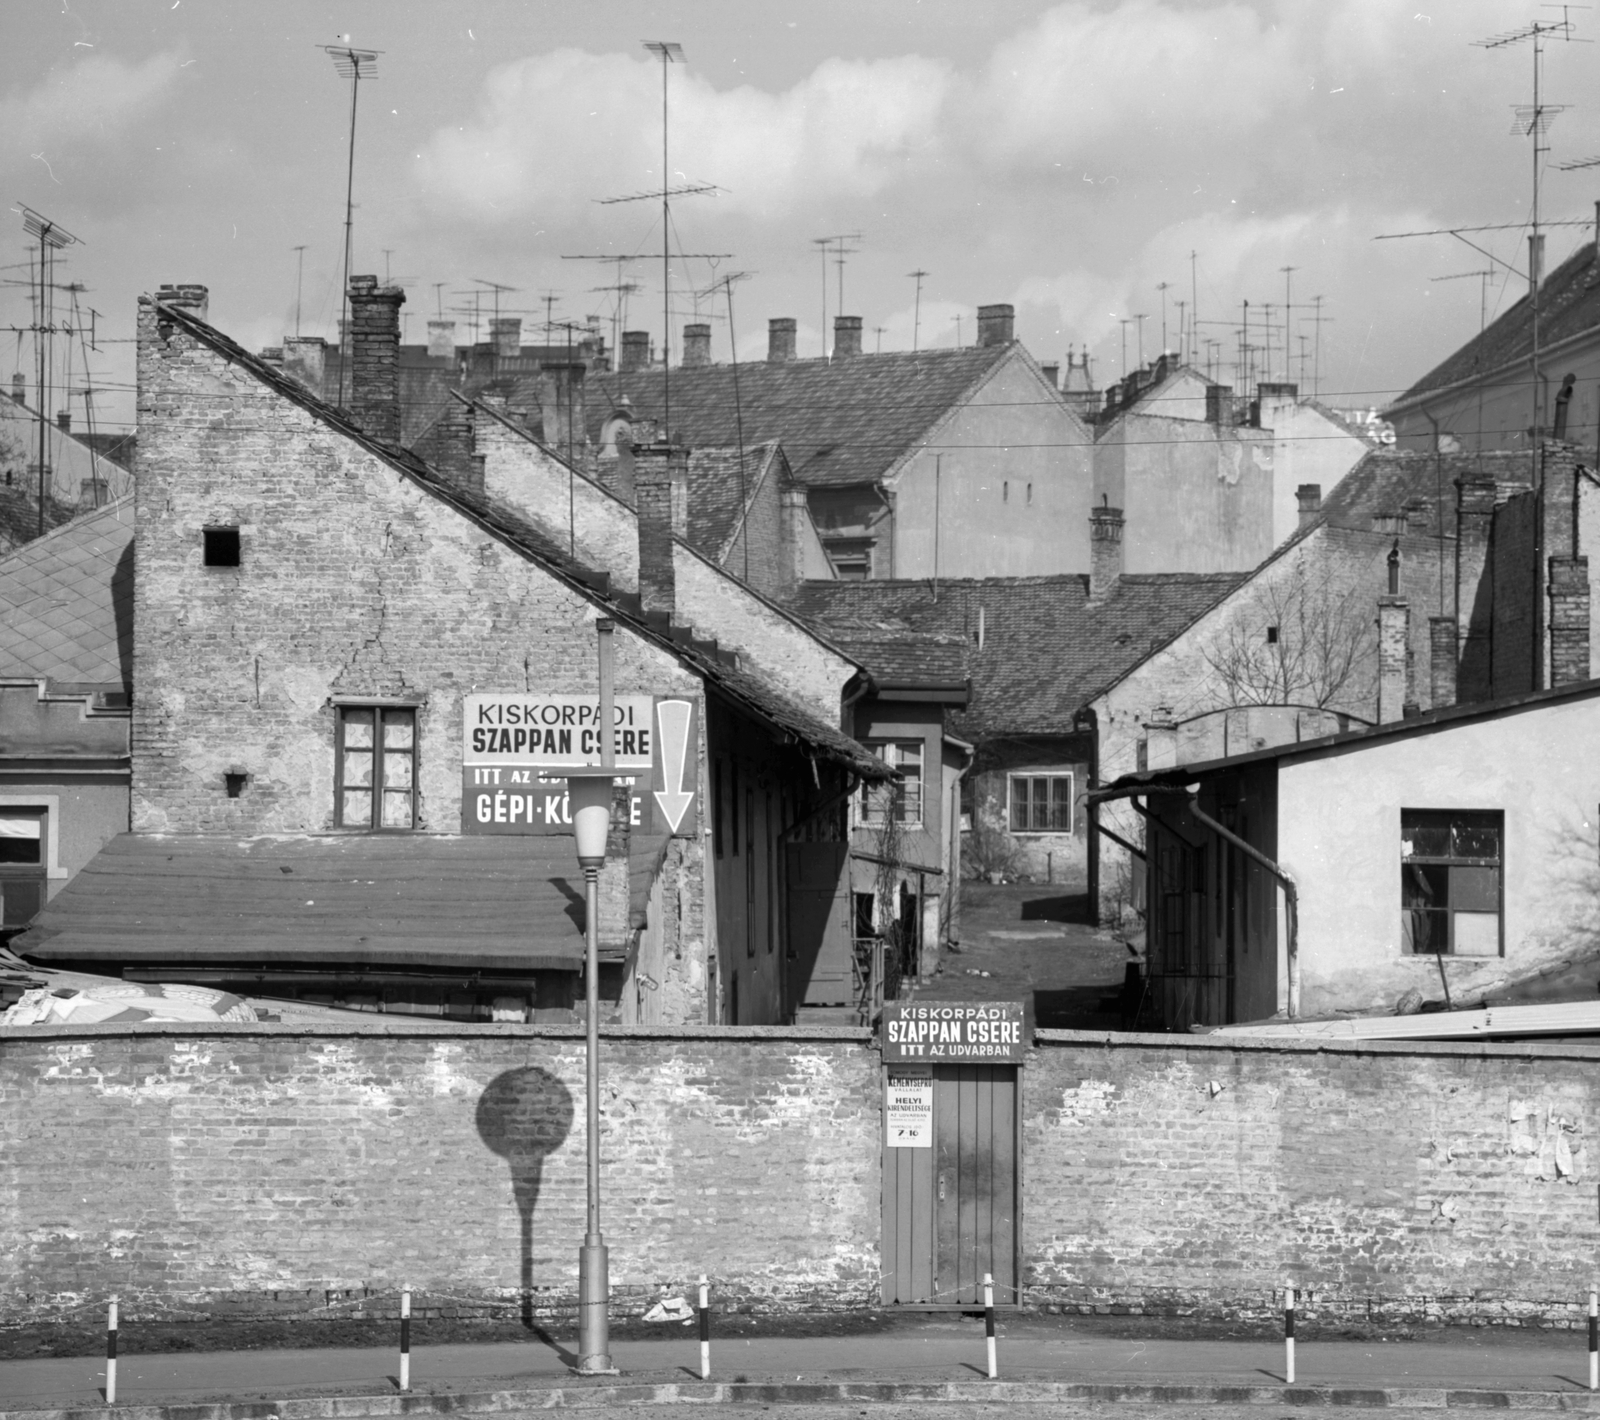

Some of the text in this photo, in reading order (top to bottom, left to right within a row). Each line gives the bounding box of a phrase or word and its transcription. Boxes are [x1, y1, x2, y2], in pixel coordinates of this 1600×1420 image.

[473, 728, 571, 754] SZAPPAN
[474, 768, 502, 785] ITT
[510, 770, 531, 784] AZ
[901, 1006, 1006, 1020] KISKORPÁDI
[889, 1021, 1020, 1044] SZAPPAN CSERE
[900, 1044, 1011, 1056] ITT AZ UDVARBAN
